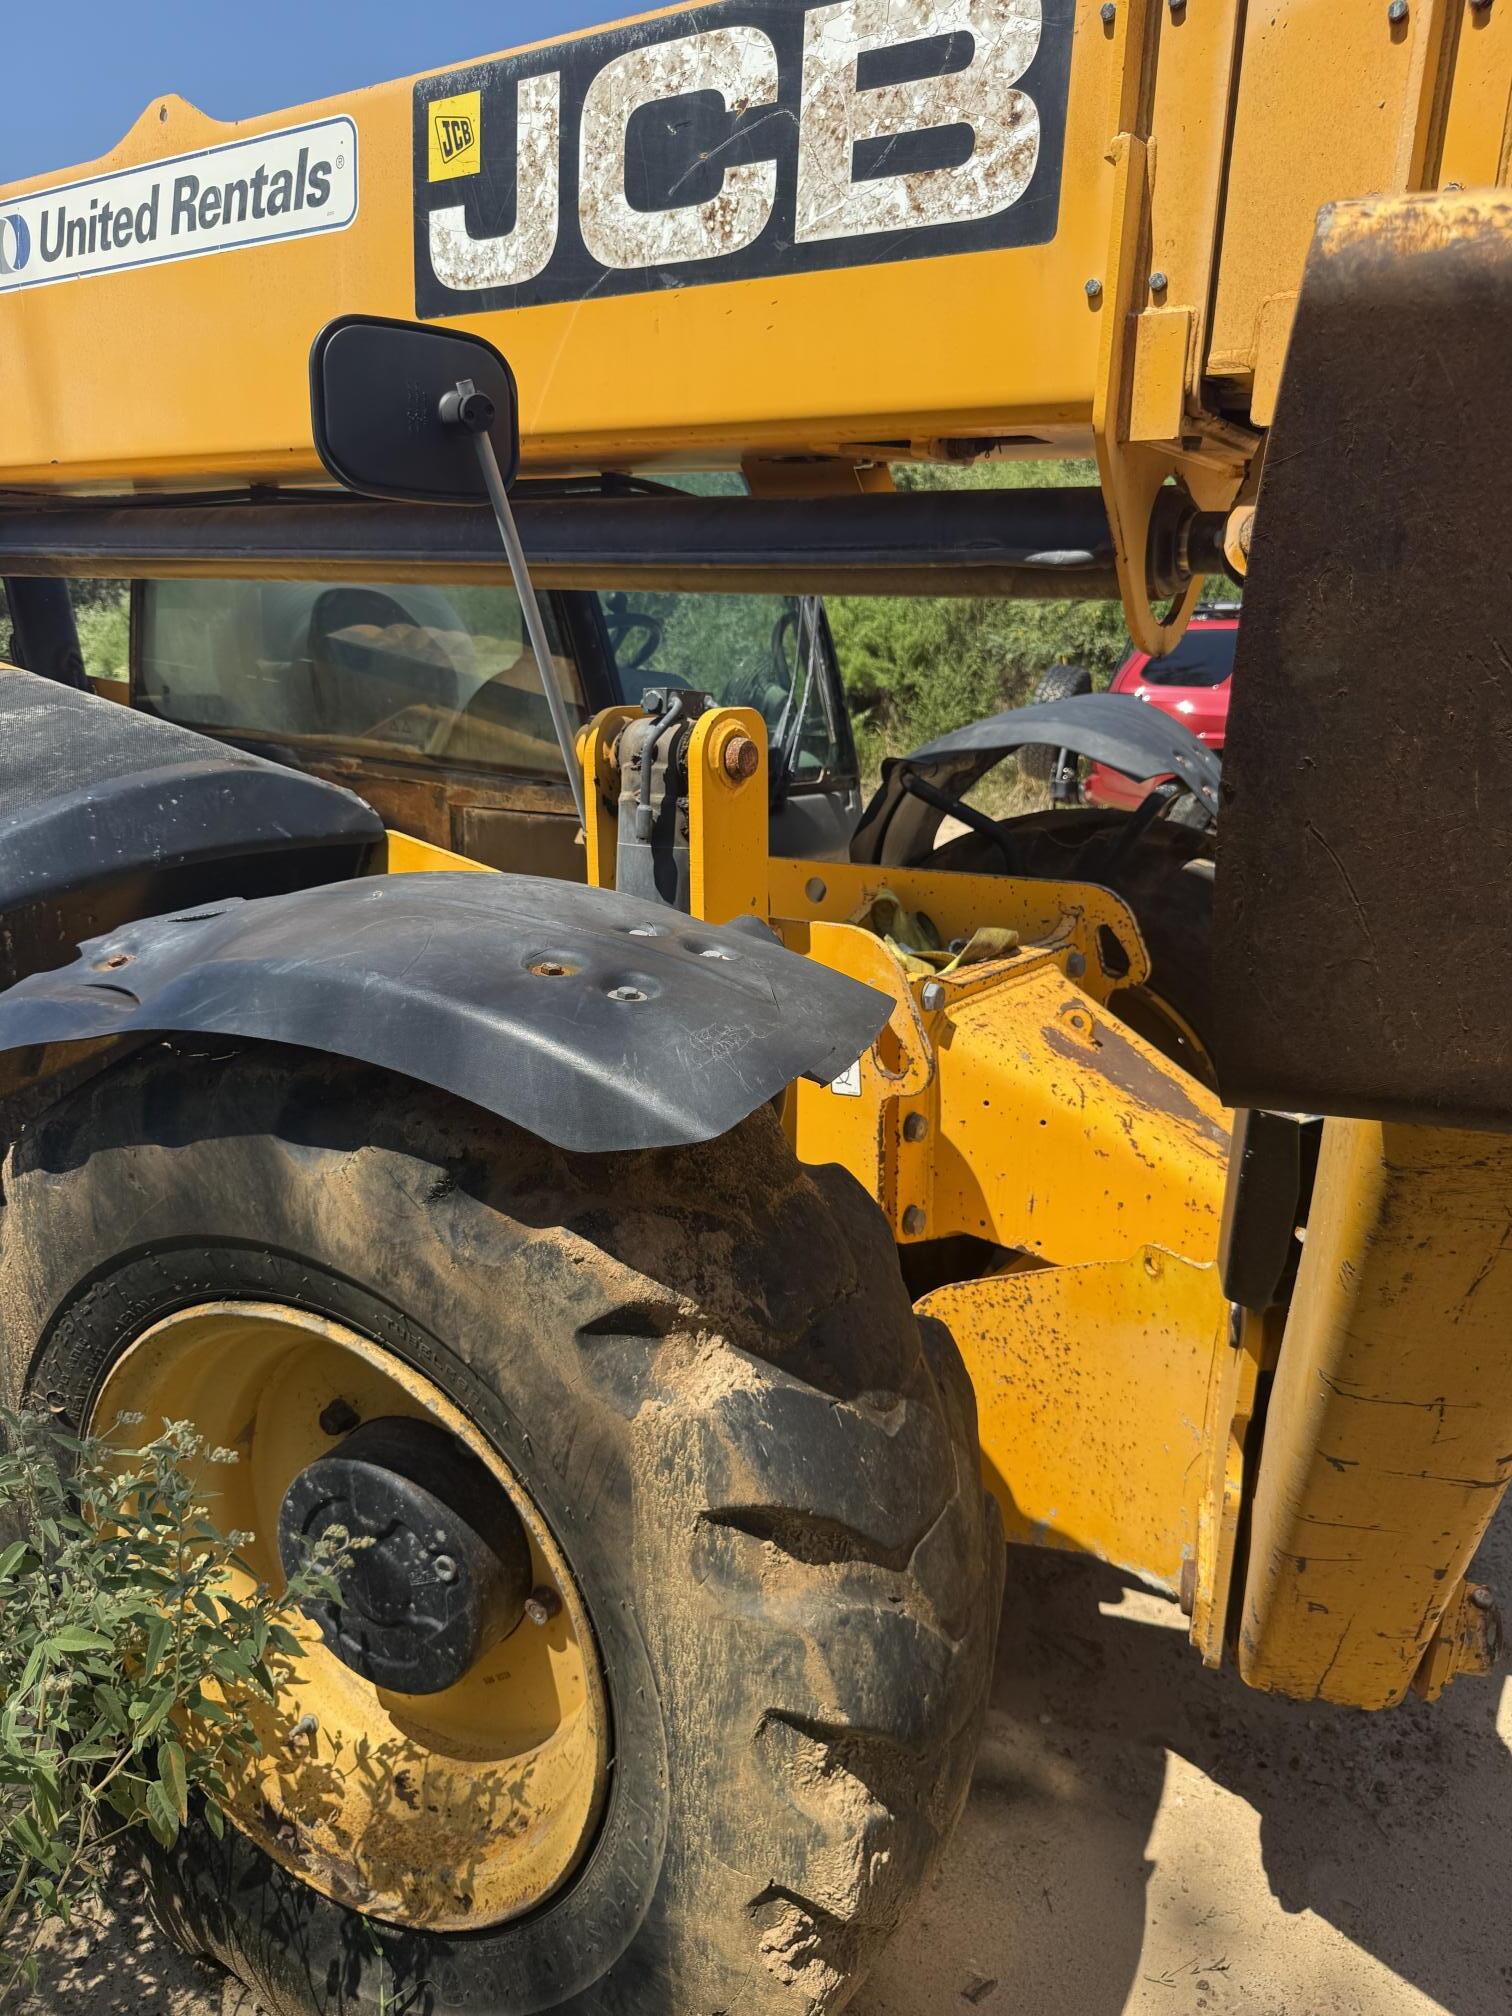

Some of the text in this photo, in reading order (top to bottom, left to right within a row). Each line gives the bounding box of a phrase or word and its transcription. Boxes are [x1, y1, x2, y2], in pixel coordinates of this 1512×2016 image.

[428, 0, 1041, 290] JCB
[442, 120, 471, 157] JCB
[40, 147, 332, 262] United Rentals
